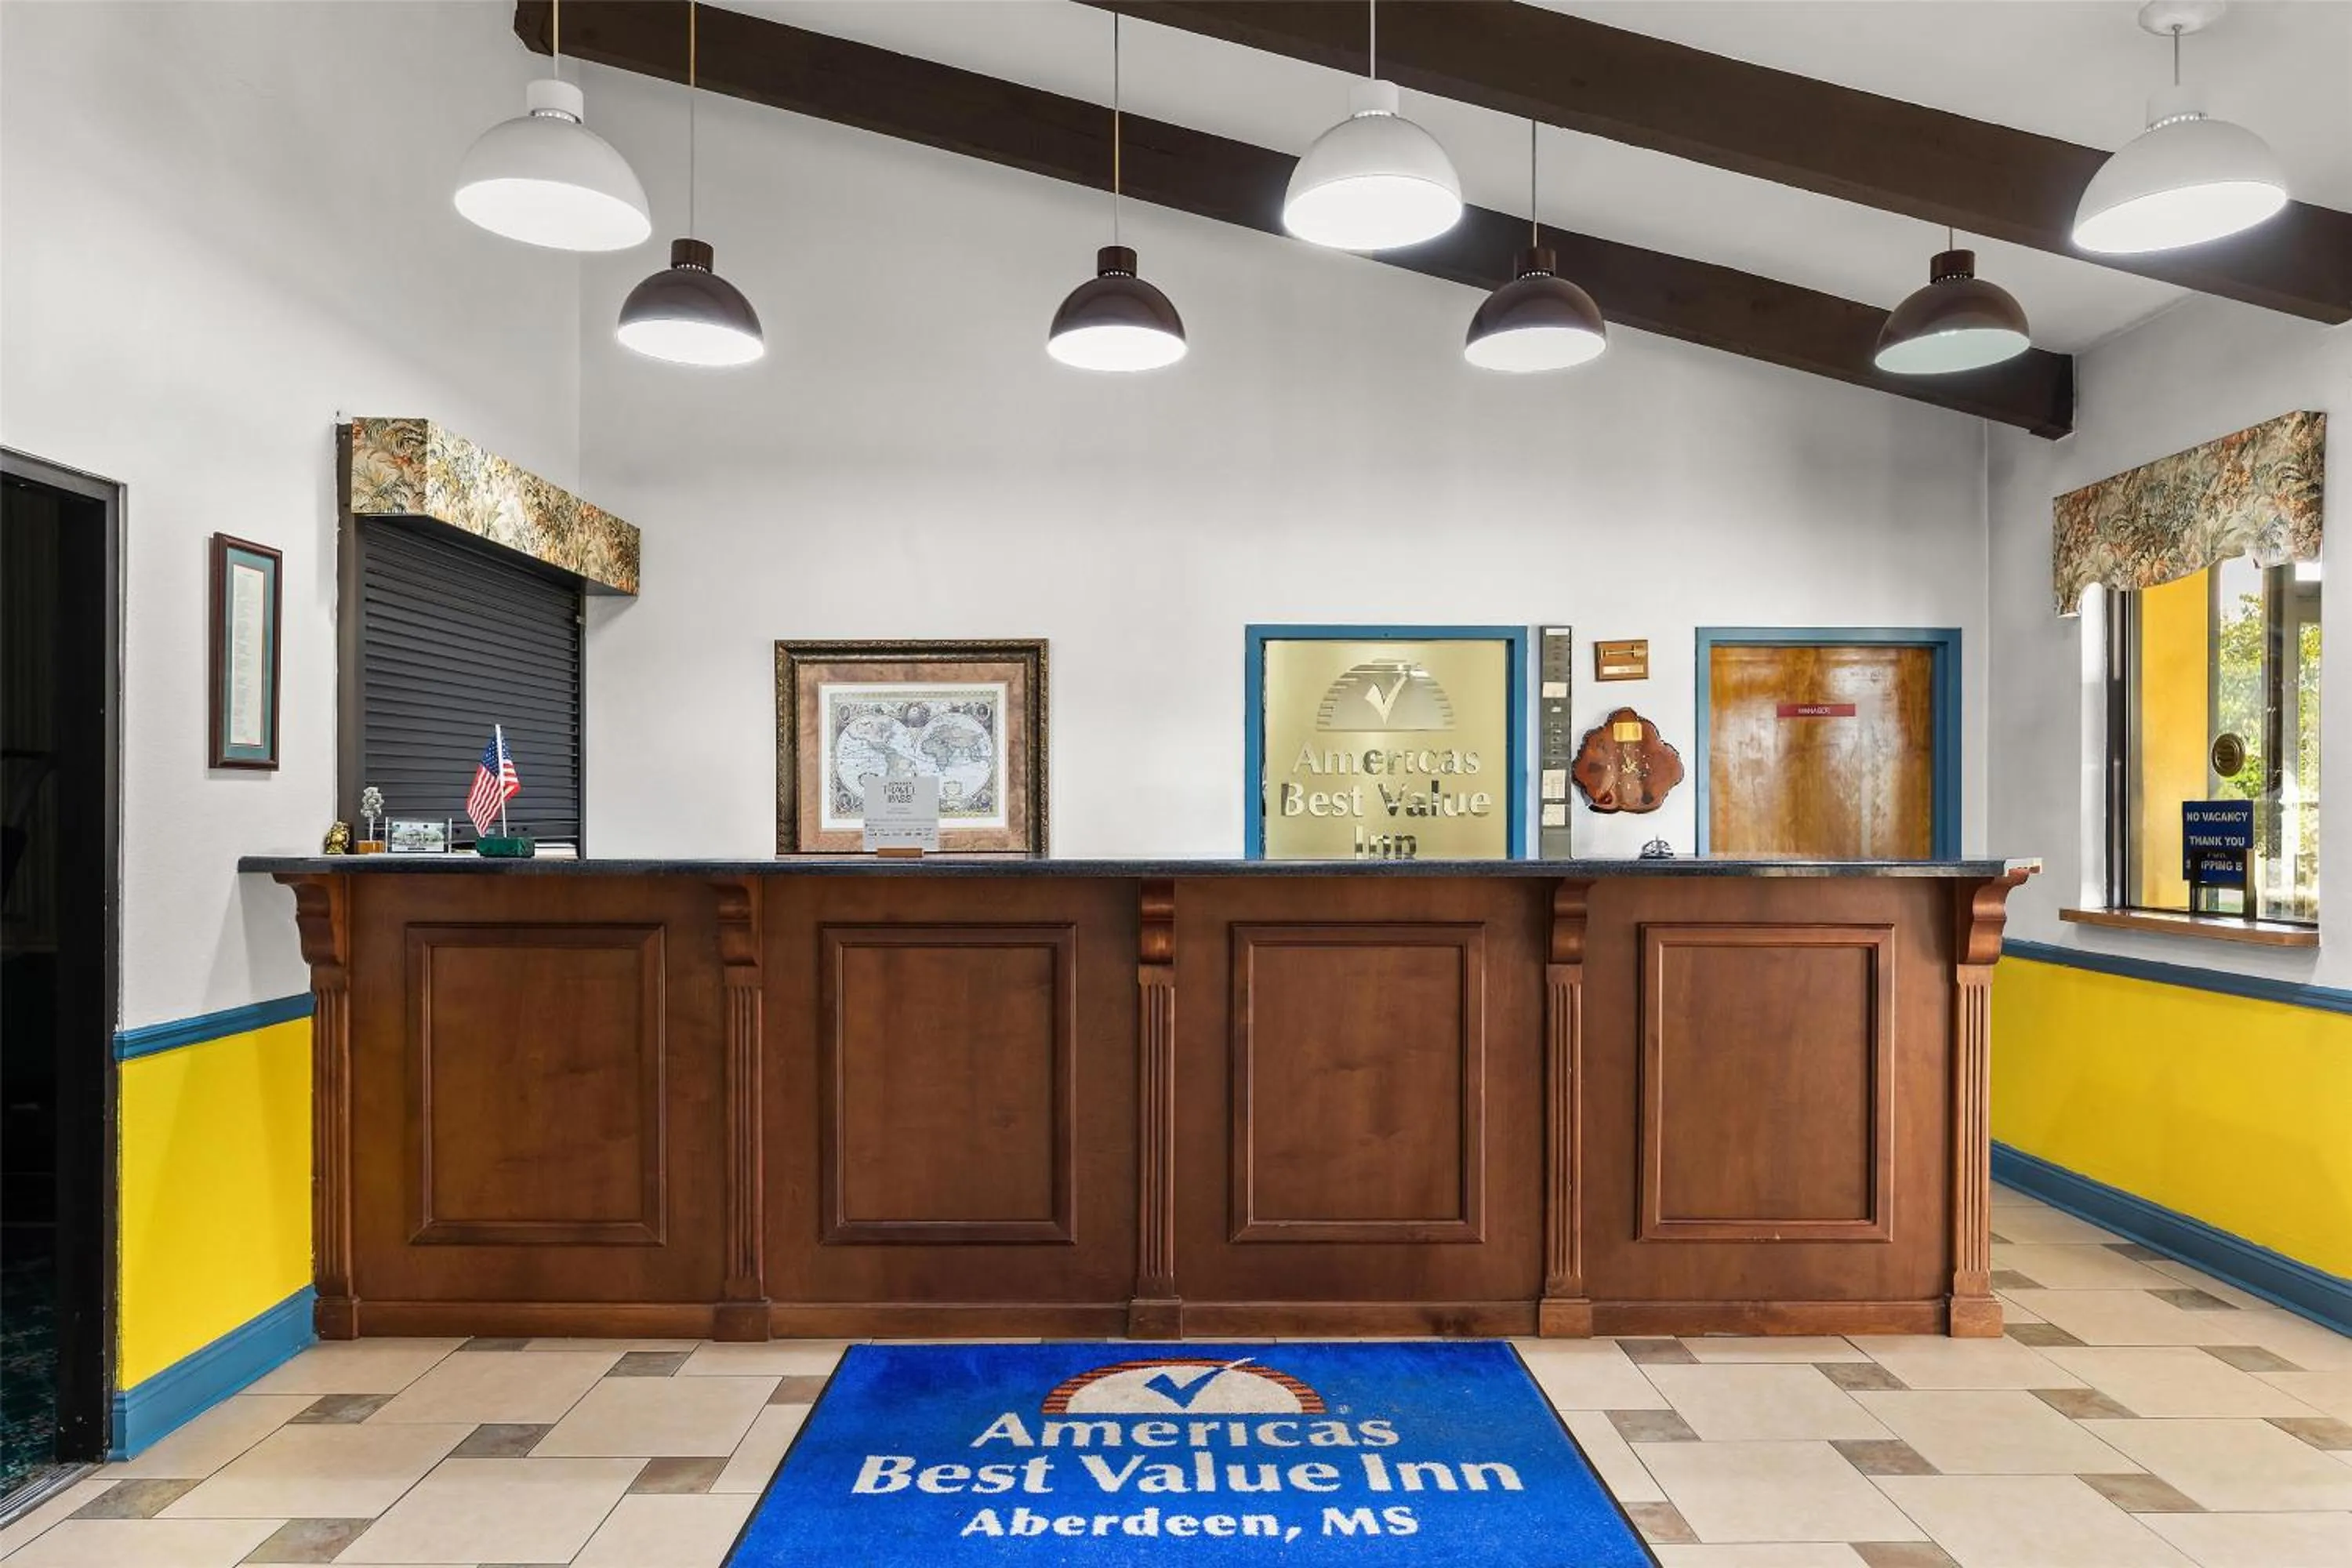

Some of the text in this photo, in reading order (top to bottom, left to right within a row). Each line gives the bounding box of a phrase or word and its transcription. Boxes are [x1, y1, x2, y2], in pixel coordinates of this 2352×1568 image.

[1292, 741, 1481, 775] Americas
[1280, 779, 1492, 818] Best Value
[2187, 811, 2248, 822] NO VACANCY
[1354, 825, 1417, 859] Inn
[2189, 835, 2245, 847] THANK YOU
[970, 1411, 1399, 1448] Americas
[851, 1450, 1525, 1494] Best Value Inn
[960, 1505, 1419, 1544] Aberdeen, MS
